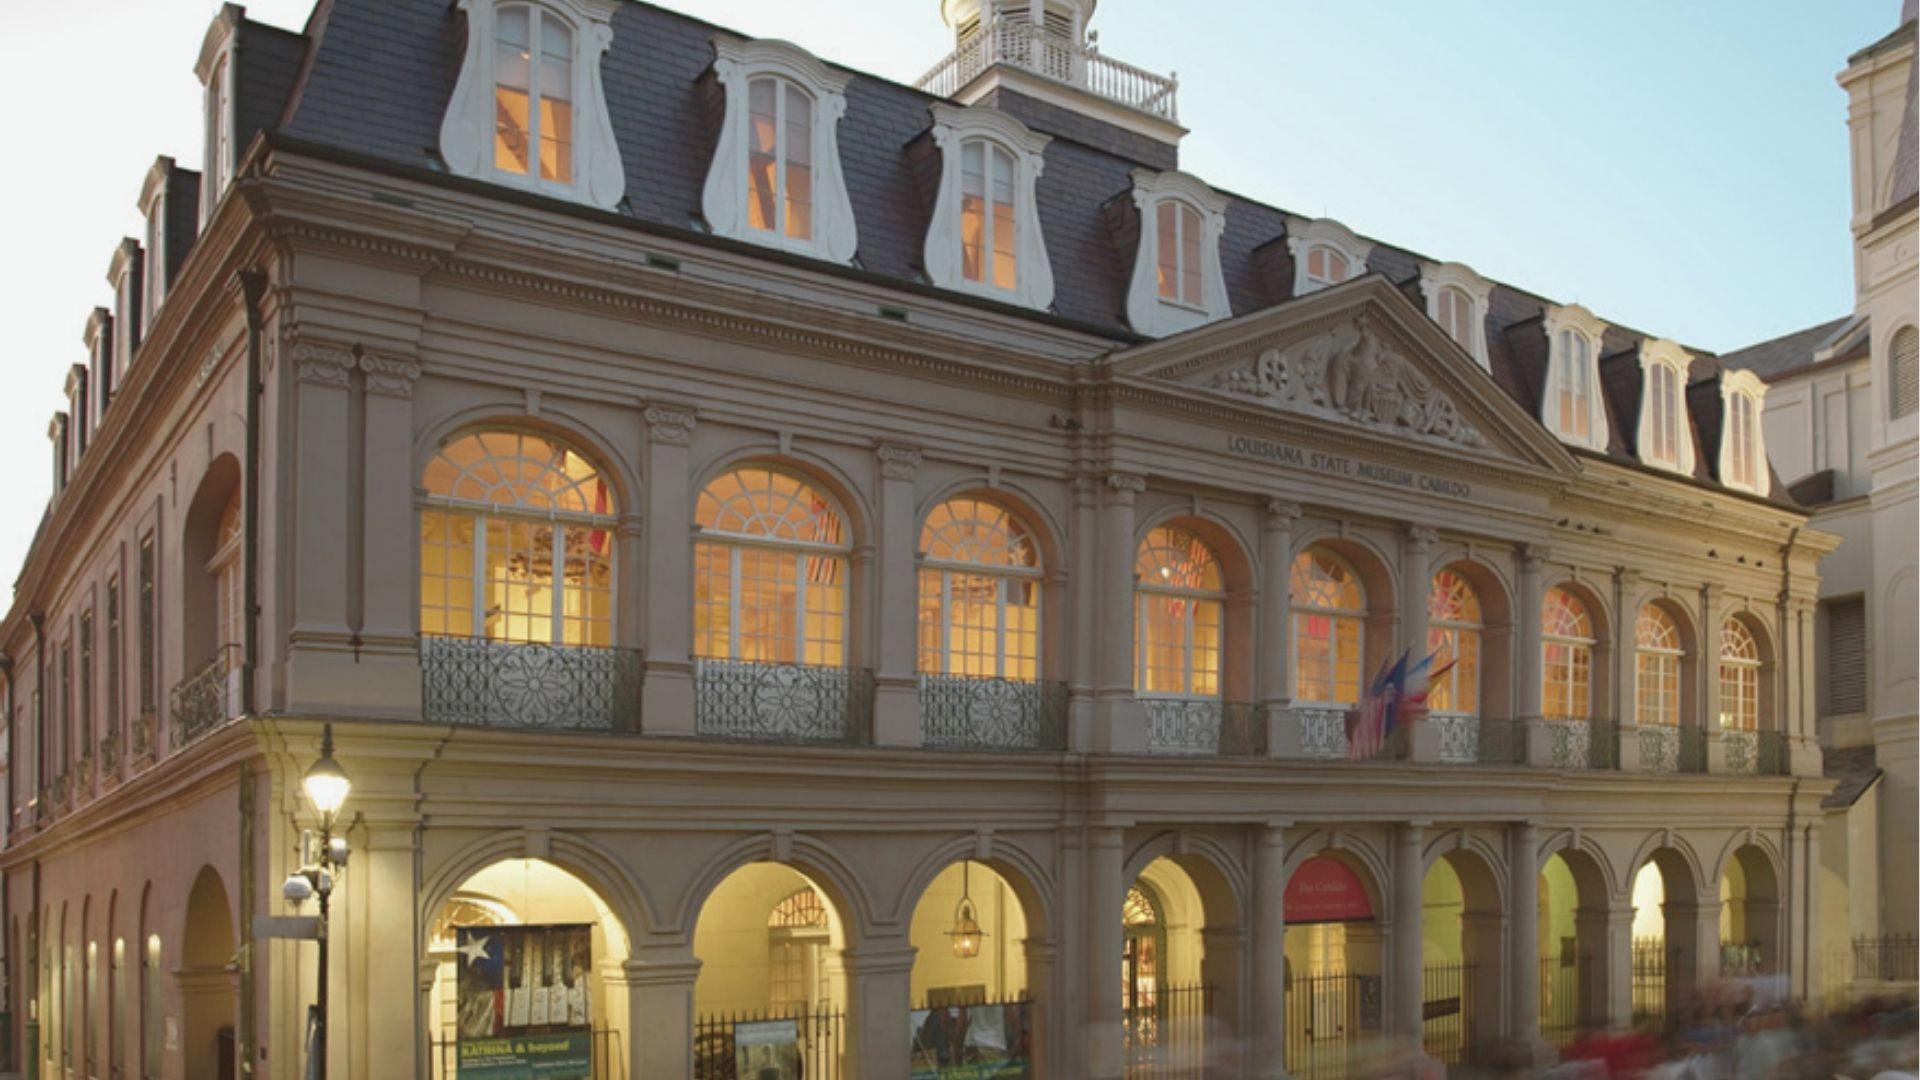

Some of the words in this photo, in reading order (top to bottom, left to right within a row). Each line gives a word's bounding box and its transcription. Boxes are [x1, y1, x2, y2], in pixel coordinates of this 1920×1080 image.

[1227, 434, 1304, 466] LOUISIANA
[1311, 452, 1350, 474] STATE
[1358, 461, 1413, 488] MUSEUM
[1419, 475, 1470, 497] CABILDO
